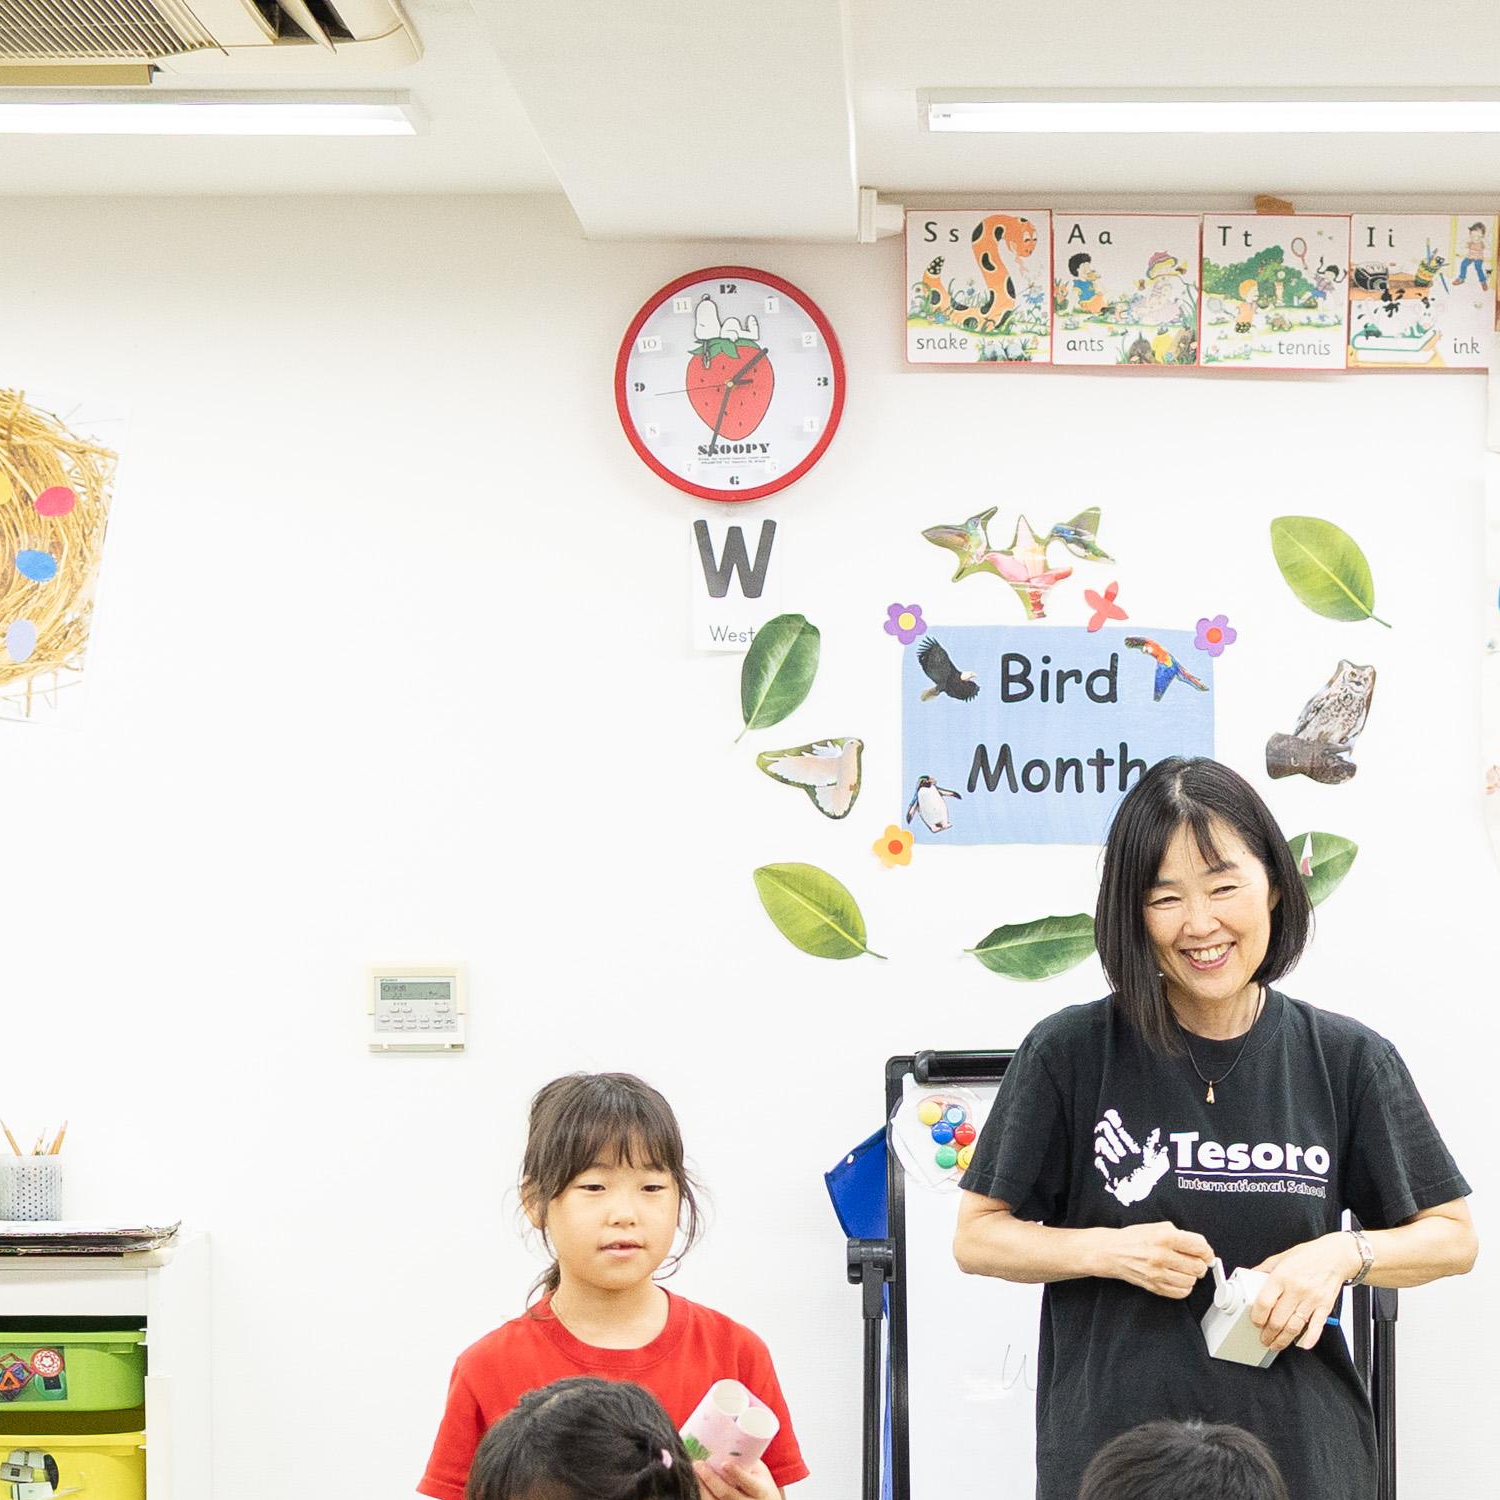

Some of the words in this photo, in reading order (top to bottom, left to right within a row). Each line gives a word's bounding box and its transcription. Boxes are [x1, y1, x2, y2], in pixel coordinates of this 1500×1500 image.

[924, 222, 937, 242] S
[949, 229, 959, 242] s
[1068, 224, 1085, 244] A
[1099, 231, 1112, 244] a
[1218, 226, 1232, 246] T
[1243, 231, 1252, 247] t
[1367, 227, 1375, 247] I
[1389, 229, 1394, 247] i
[720, 284, 737, 294] 12
[675, 300, 690, 311] 11
[641, 338, 657, 350] 10
[805, 335, 813, 345] 2
[917, 333, 967, 350] snake
[1067, 338, 1104, 351] ants
[1278, 341, 1330, 355] tennis
[1454, 337, 1480, 354] ink
[634, 383, 645, 392] 9
[817, 377, 828, 386] 3
[649, 426, 656, 434] 8
[698, 443, 770, 456] SOOPY
[730, 476, 739, 485] 6
[693, 519, 777, 598] W
[709, 624, 755, 643] West
[1001, 653, 1118, 703] Bird
[966, 742, 1149, 793] Month
[1170, 1131, 1330, 1175] Tesoro
[1178, 1177, 1286, 1192] International
[1287, 1181, 1326, 1198] School
